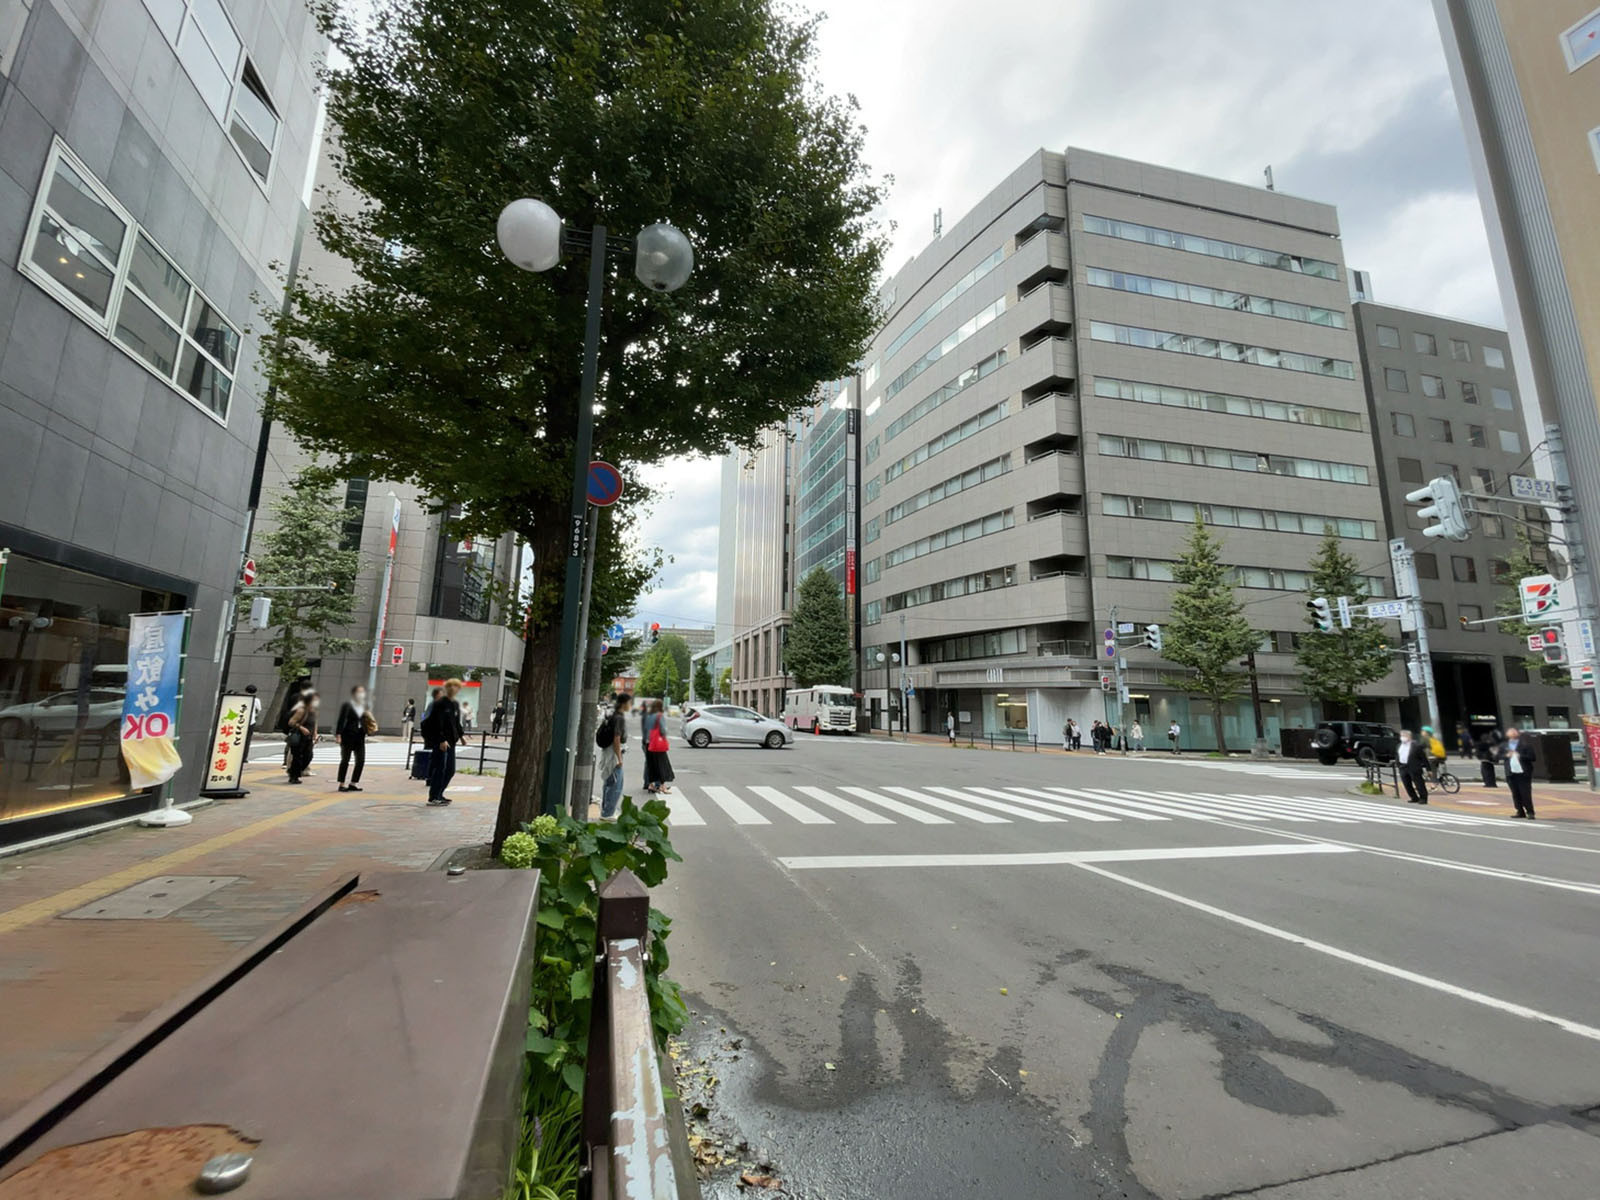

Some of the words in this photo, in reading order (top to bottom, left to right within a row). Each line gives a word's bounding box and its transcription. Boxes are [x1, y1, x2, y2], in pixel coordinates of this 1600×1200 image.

[572, 519, 581, 557] 96893
[233, 703, 248, 746] まるごと
[215, 725, 234, 771] 北海道
